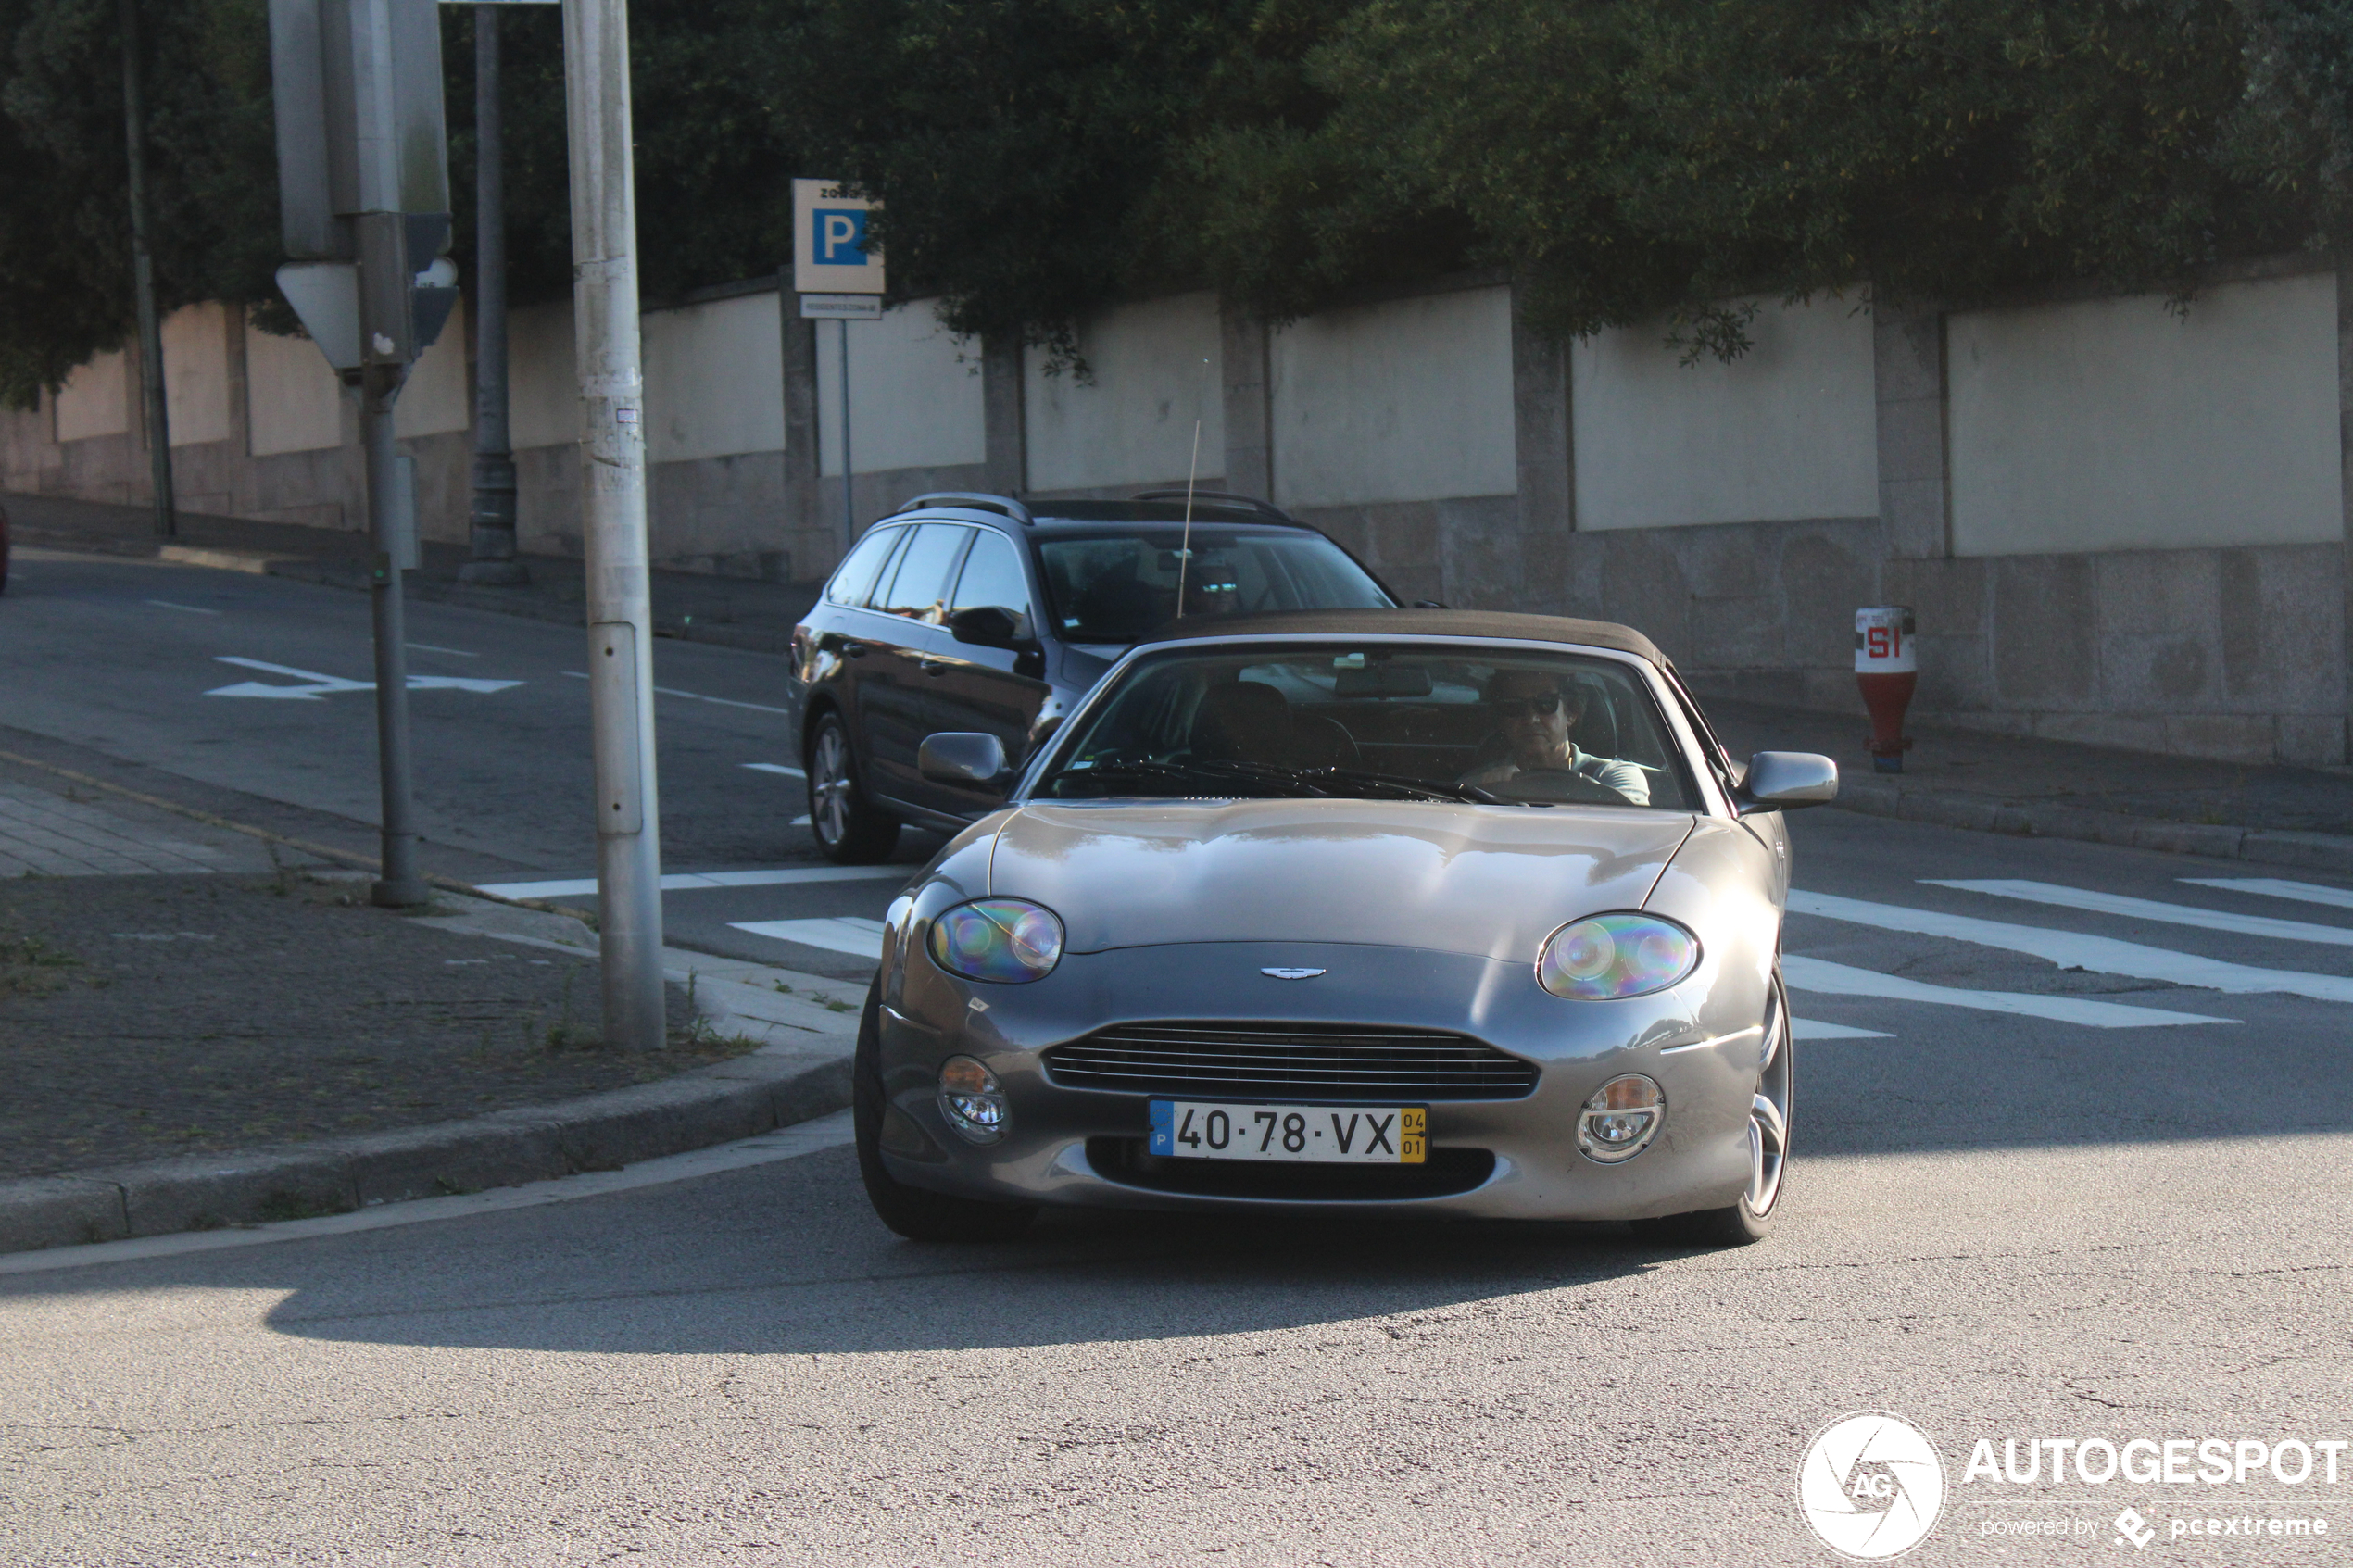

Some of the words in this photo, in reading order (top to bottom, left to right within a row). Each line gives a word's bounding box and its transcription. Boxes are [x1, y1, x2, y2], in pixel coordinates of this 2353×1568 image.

[824, 216, 855, 258] P
[1403, 1114, 1424, 1129] 04
[1157, 1134, 1166, 1146] P
[1403, 1140, 1422, 1155] 01
